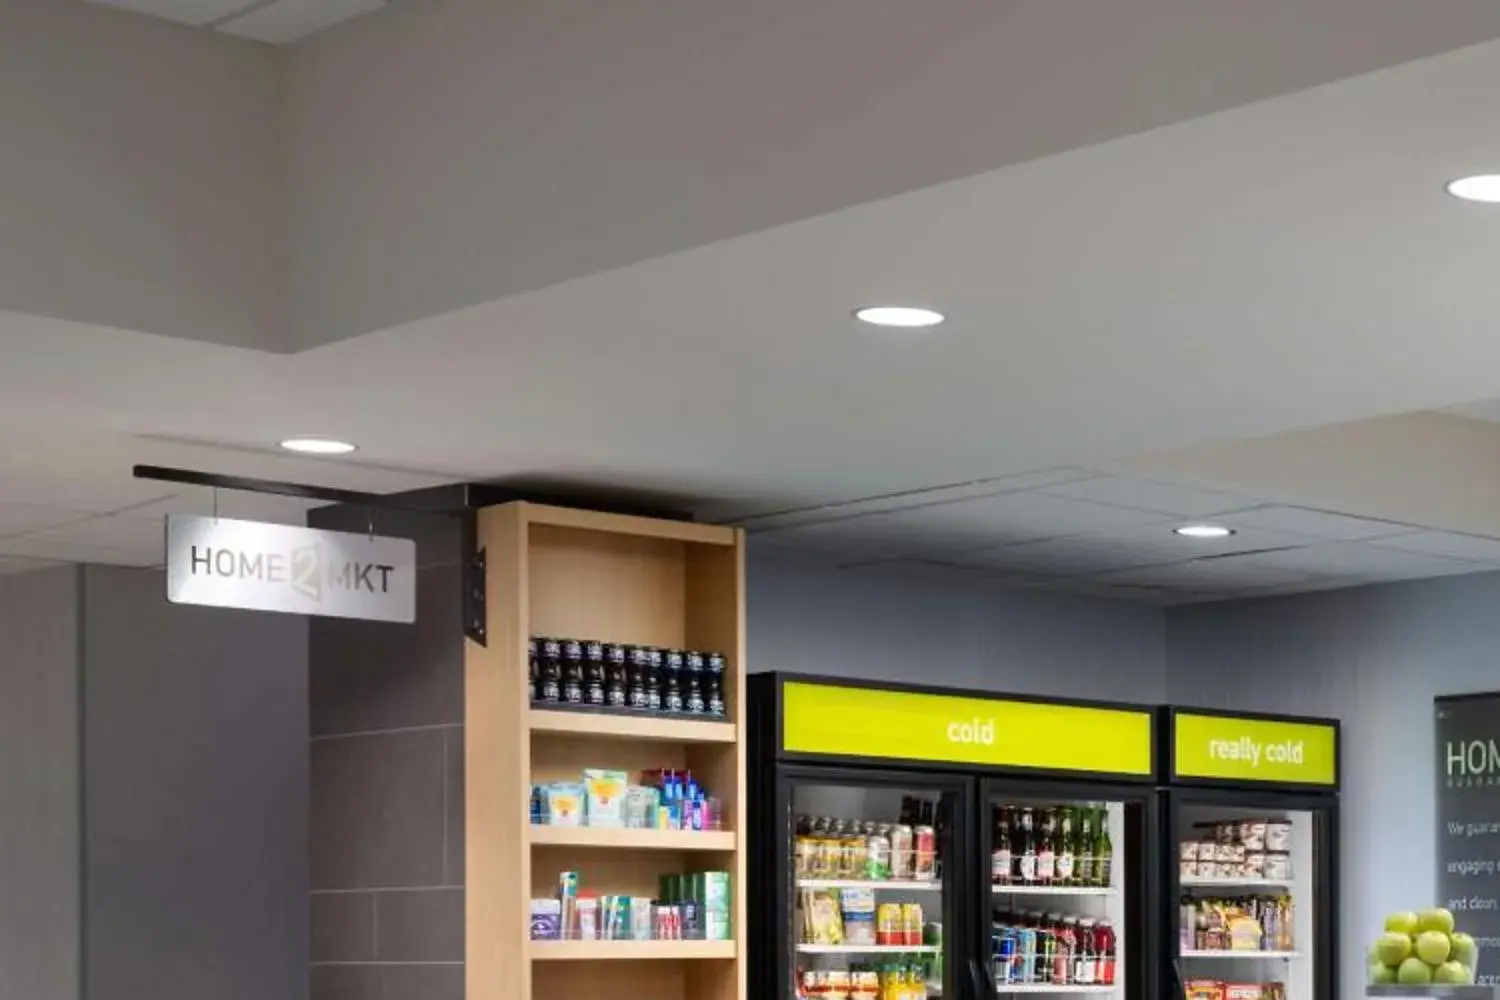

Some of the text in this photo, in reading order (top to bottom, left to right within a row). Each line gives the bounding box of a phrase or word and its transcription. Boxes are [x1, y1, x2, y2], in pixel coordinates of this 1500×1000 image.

[947, 717, 994, 746] cold
[1210, 736, 1303, 769] really cold
[1447, 821, 1464, 835] We
